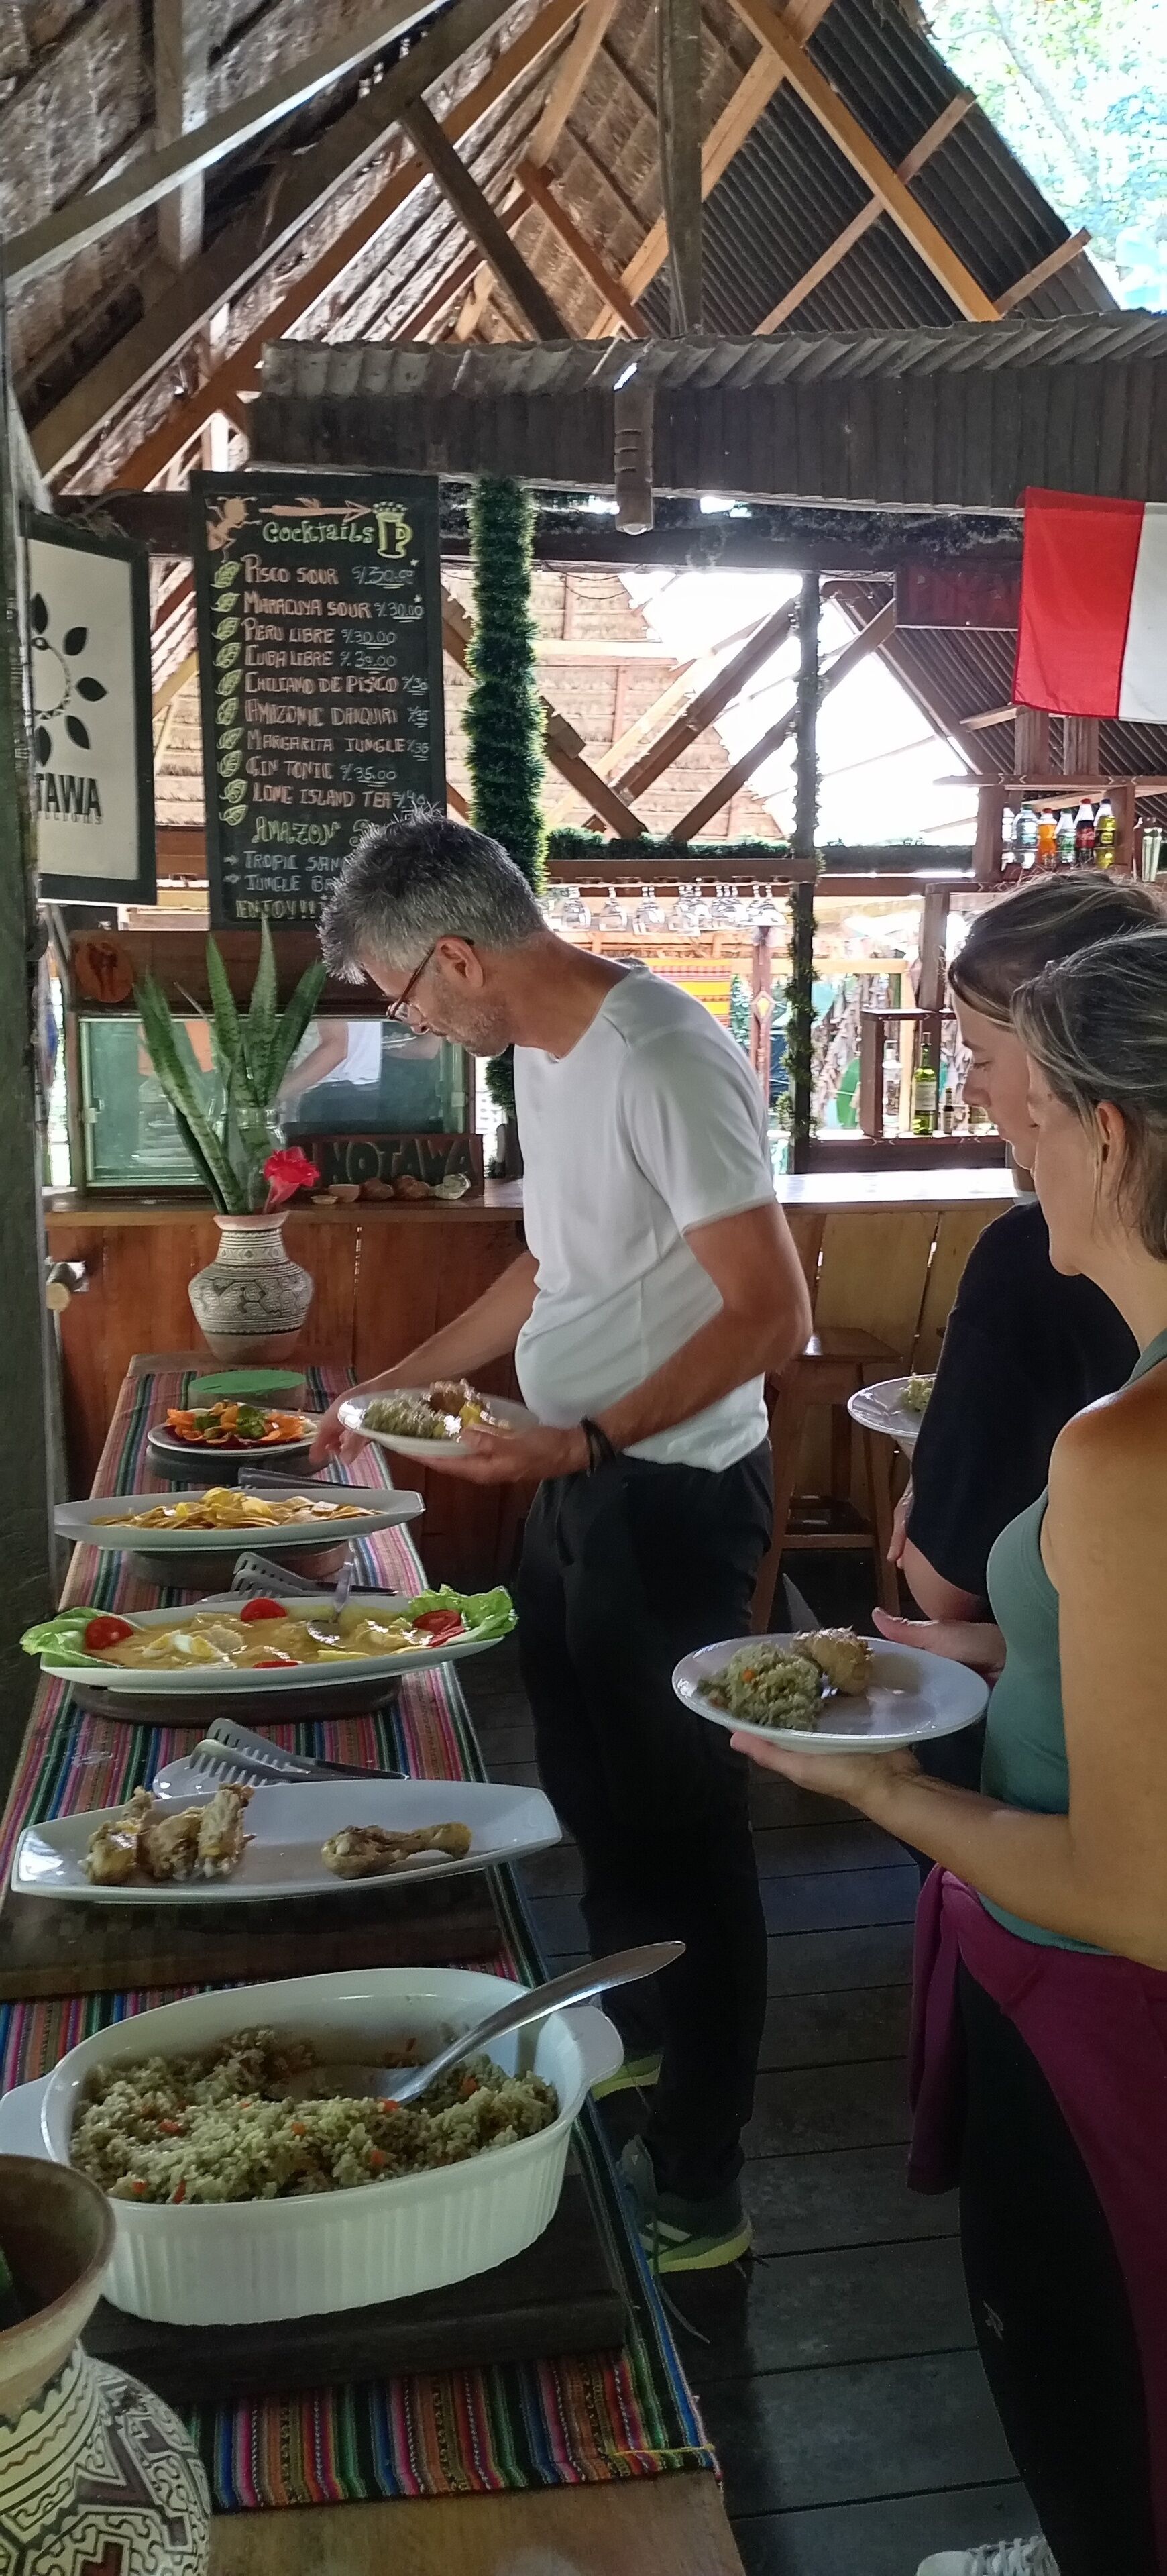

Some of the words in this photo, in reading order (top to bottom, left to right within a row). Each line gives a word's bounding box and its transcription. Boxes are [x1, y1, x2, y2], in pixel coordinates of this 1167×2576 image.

[262, 520, 376, 544] Cocktails
[241, 553, 290, 584] PISCO
[297, 567, 339, 584] SOUR
[243, 591, 323, 616] MARACUYA
[327, 601, 372, 619] SOUR
[241, 617, 283, 642] PERU
[289, 628, 335, 643] LIBRE
[245, 645, 287, 669] CUBA
[290, 651, 333, 667] LIBRE
[319, 676, 342, 692] DE
[346, 676, 399, 693] PISCO
[245, 698, 325, 727] AMAZONIC
[331, 707, 398, 725] DAIQUIRI
[247, 729, 335, 751] MARGARITA
[344, 737, 406, 753] JUNGLE
[245, 755, 280, 777] GIN
[284, 761, 335, 780] TONIC
[300, 788, 355, 808] ISLAND
[362, 790, 392, 809] TEA
[252, 816, 341, 846] AMAZON
[244, 850, 298, 871] TROPIC
[245, 875, 301, 892] JUNGLE
